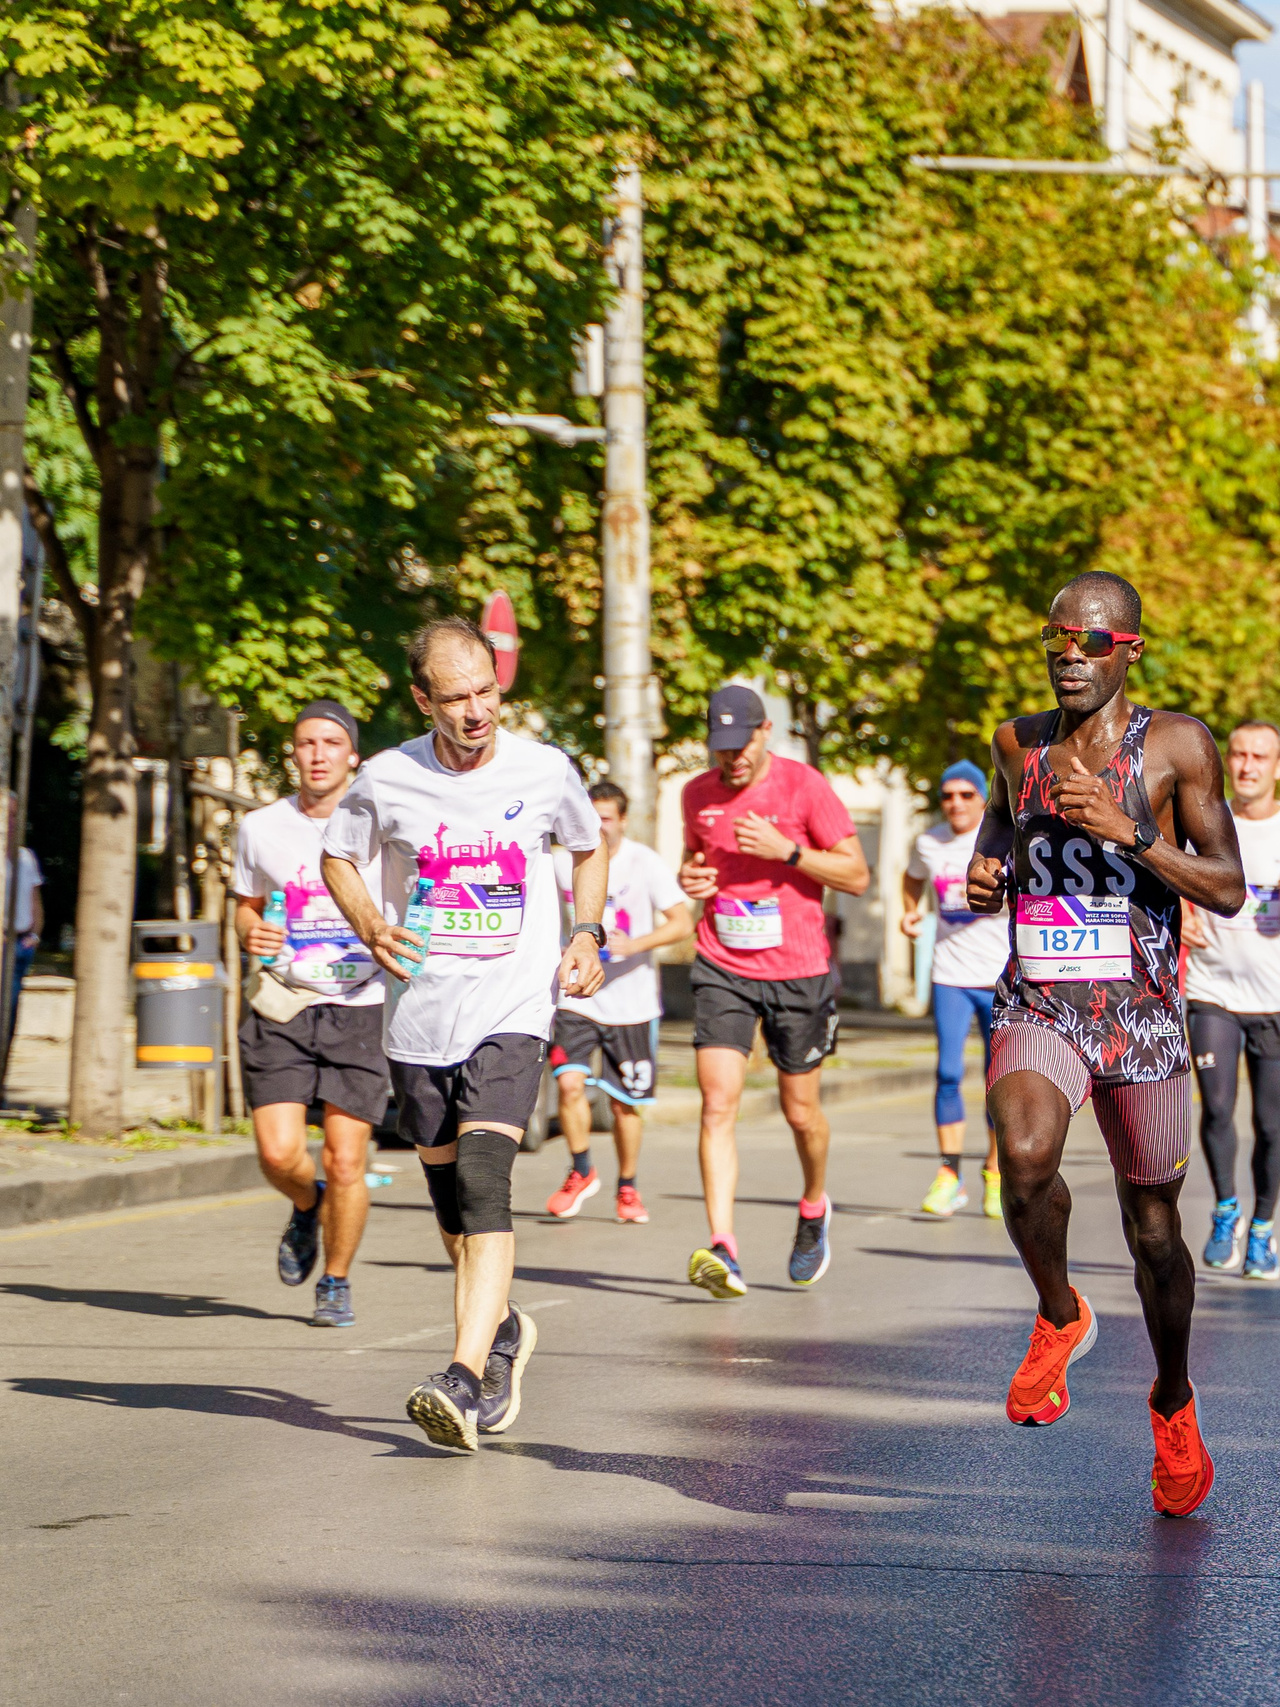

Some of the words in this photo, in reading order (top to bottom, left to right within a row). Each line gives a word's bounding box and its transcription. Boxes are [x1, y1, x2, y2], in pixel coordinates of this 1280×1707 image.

[443, 911, 502, 931] 3310
[727, 919, 766, 932] 3522
[290, 930, 341, 940] MARATHON
[1039, 929, 1099, 952] 1871
[311, 964, 357, 979] 3012
